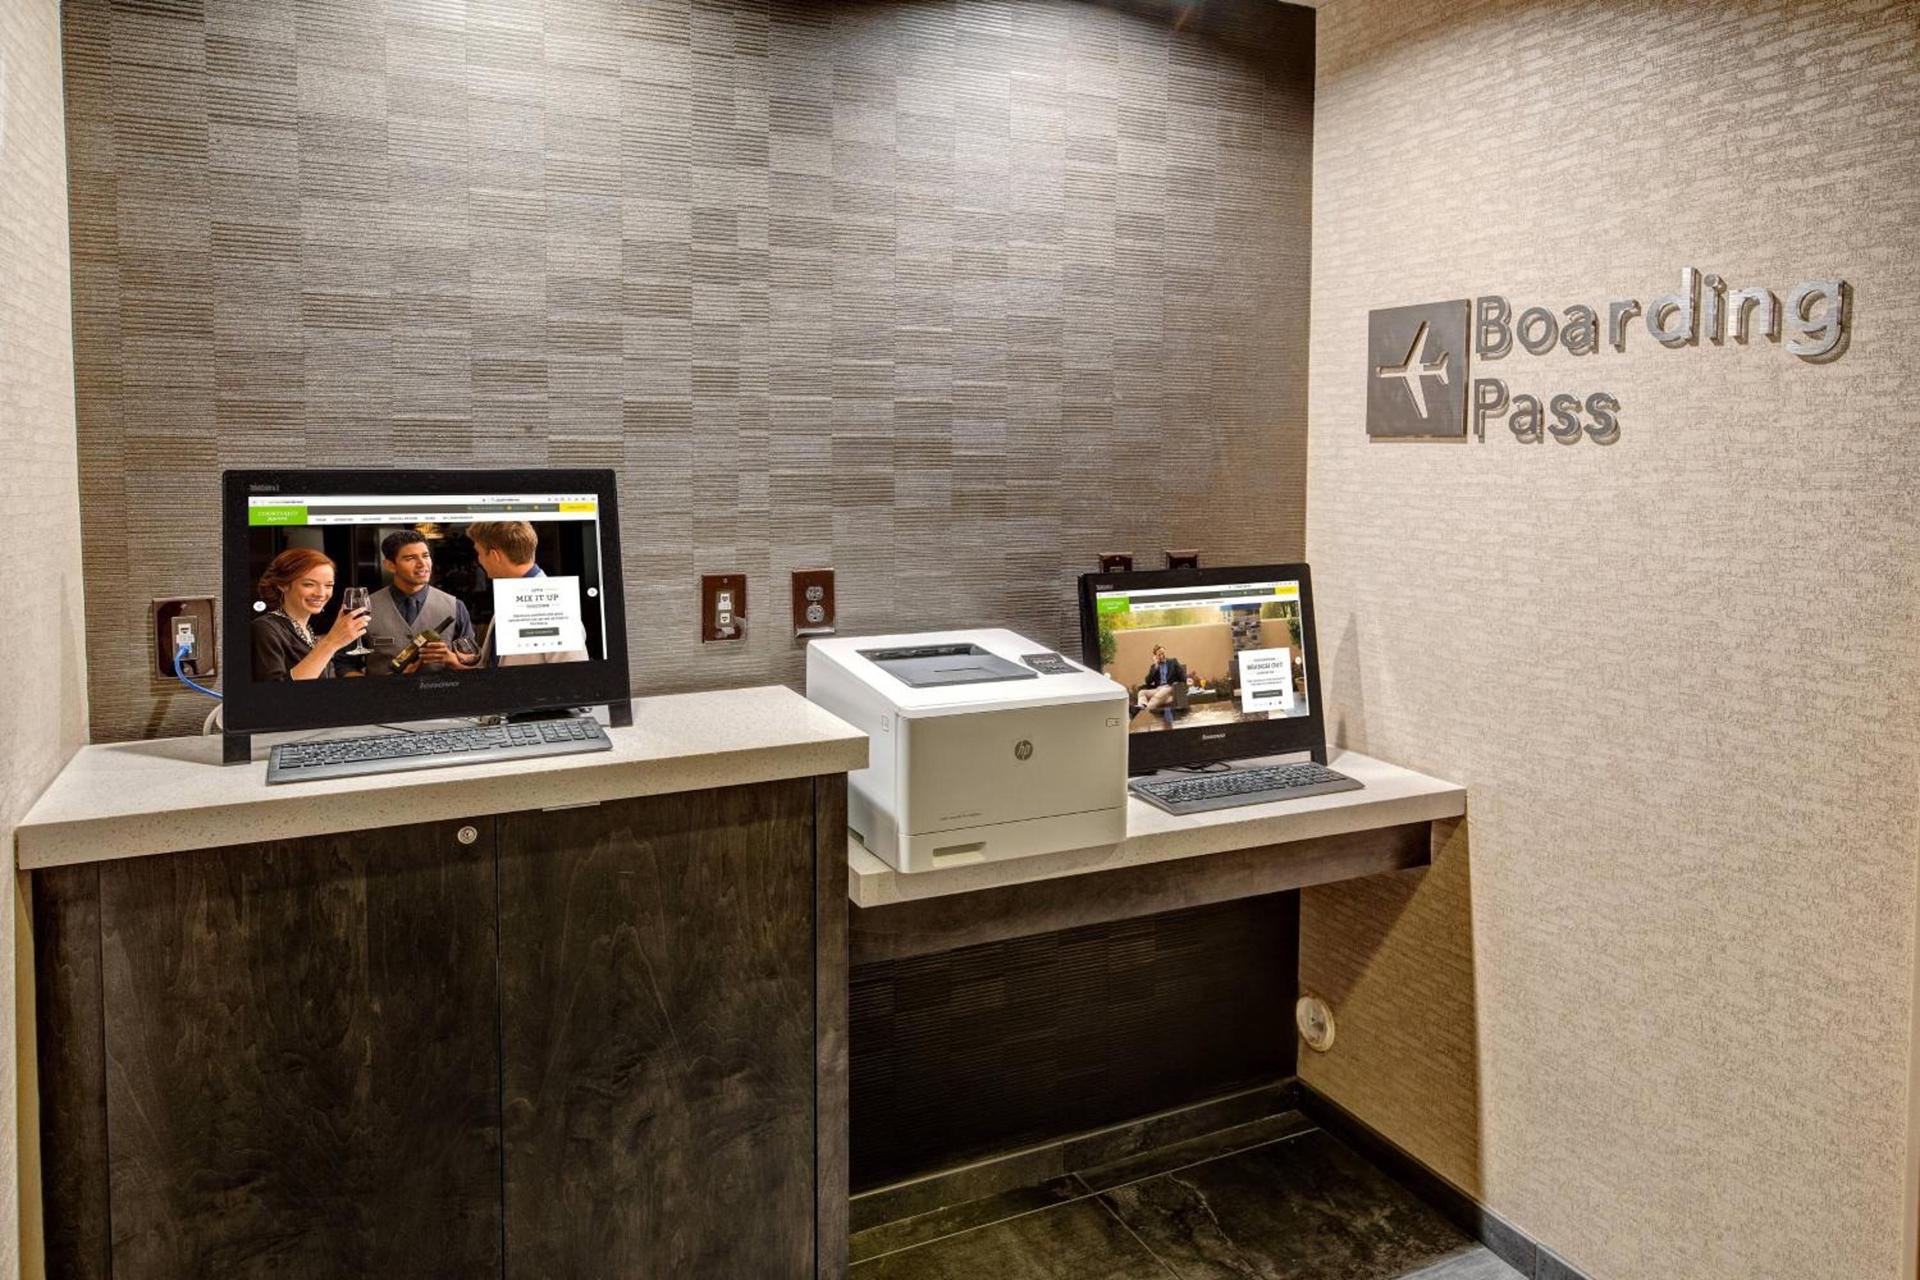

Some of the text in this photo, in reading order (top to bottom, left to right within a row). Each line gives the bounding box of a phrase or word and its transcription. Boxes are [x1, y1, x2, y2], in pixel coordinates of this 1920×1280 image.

[1475, 266, 1850, 360] Boarding
[1473, 378, 1621, 444] Pass
[515, 593, 560, 603] MIX IT UP
